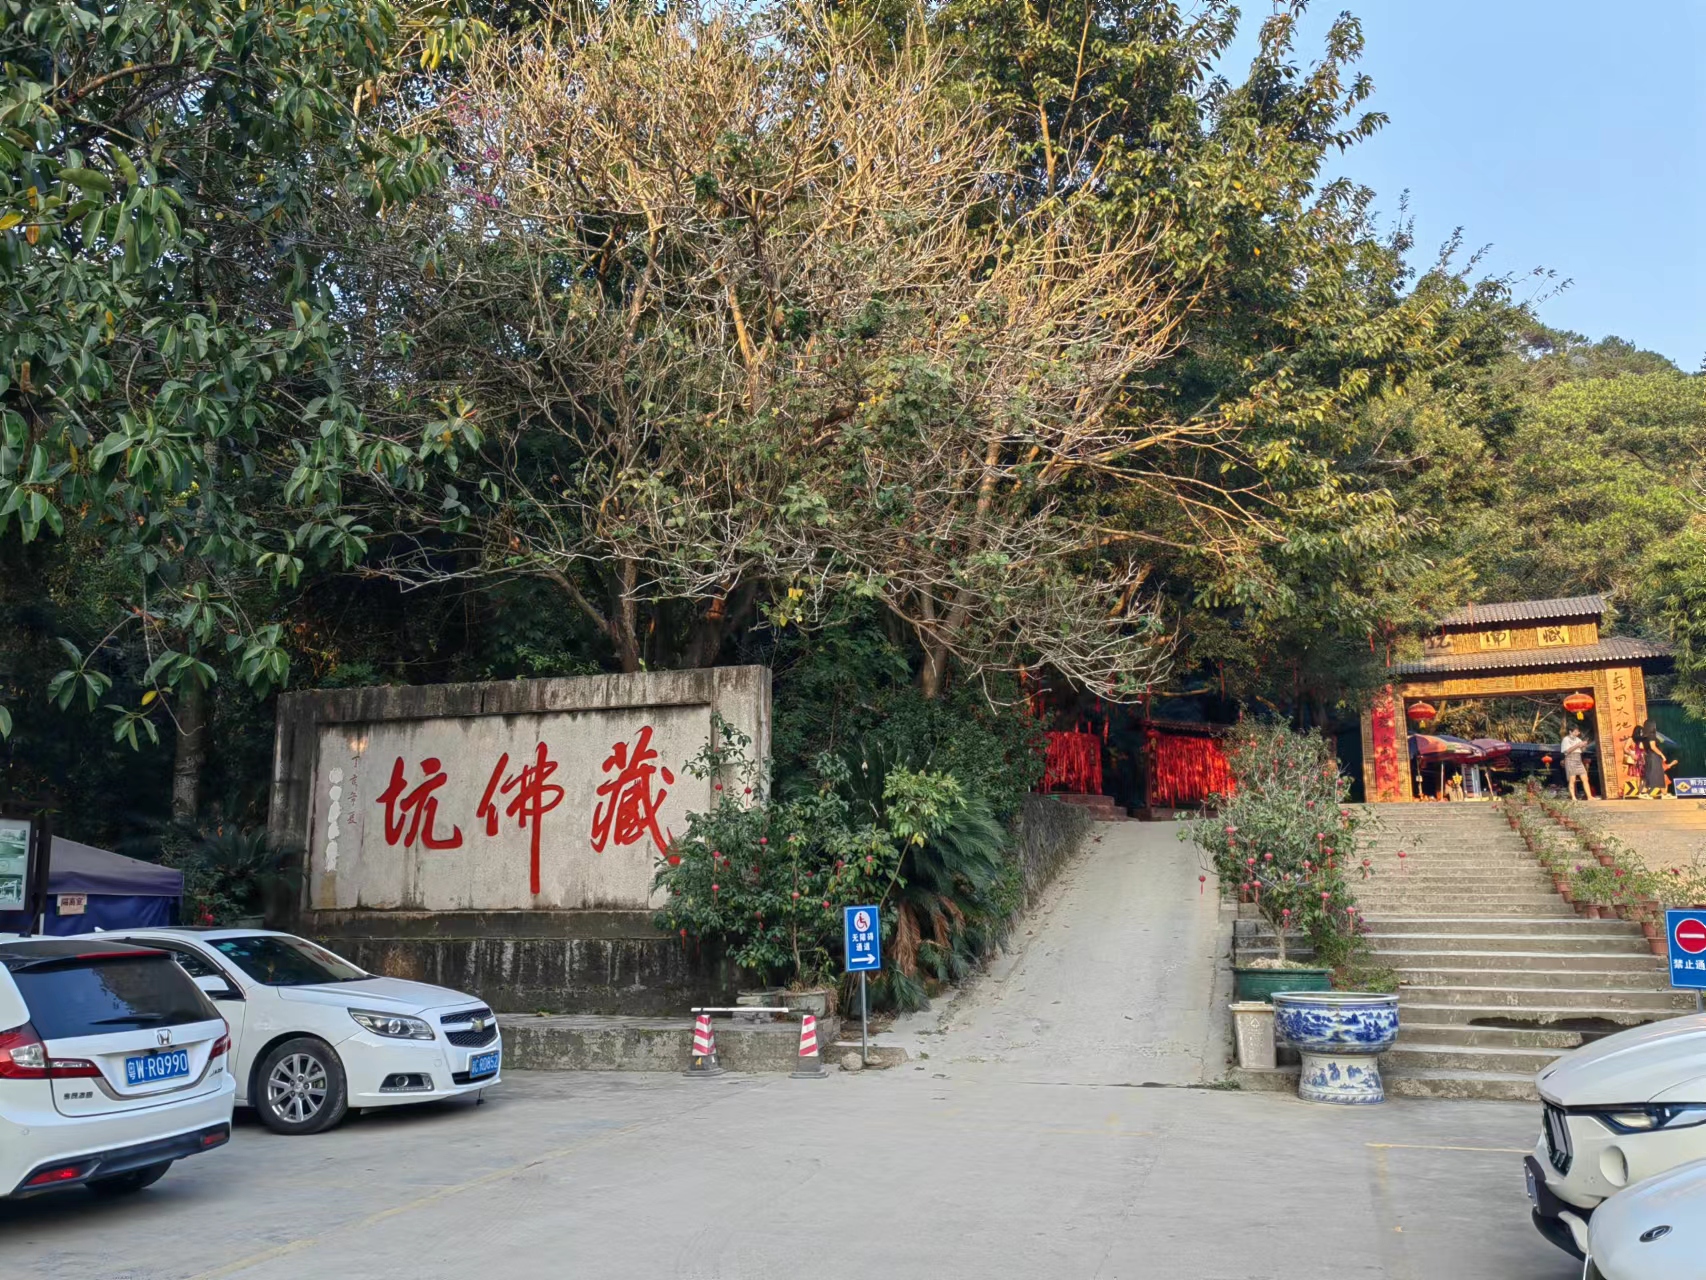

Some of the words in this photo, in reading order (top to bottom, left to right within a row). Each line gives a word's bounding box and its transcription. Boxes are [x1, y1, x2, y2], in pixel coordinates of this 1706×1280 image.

[852, 932, 874, 942] 无障碍
[856, 942, 871, 951] 通道
[128, 1053, 188, 1080] 粤W·RQ990
